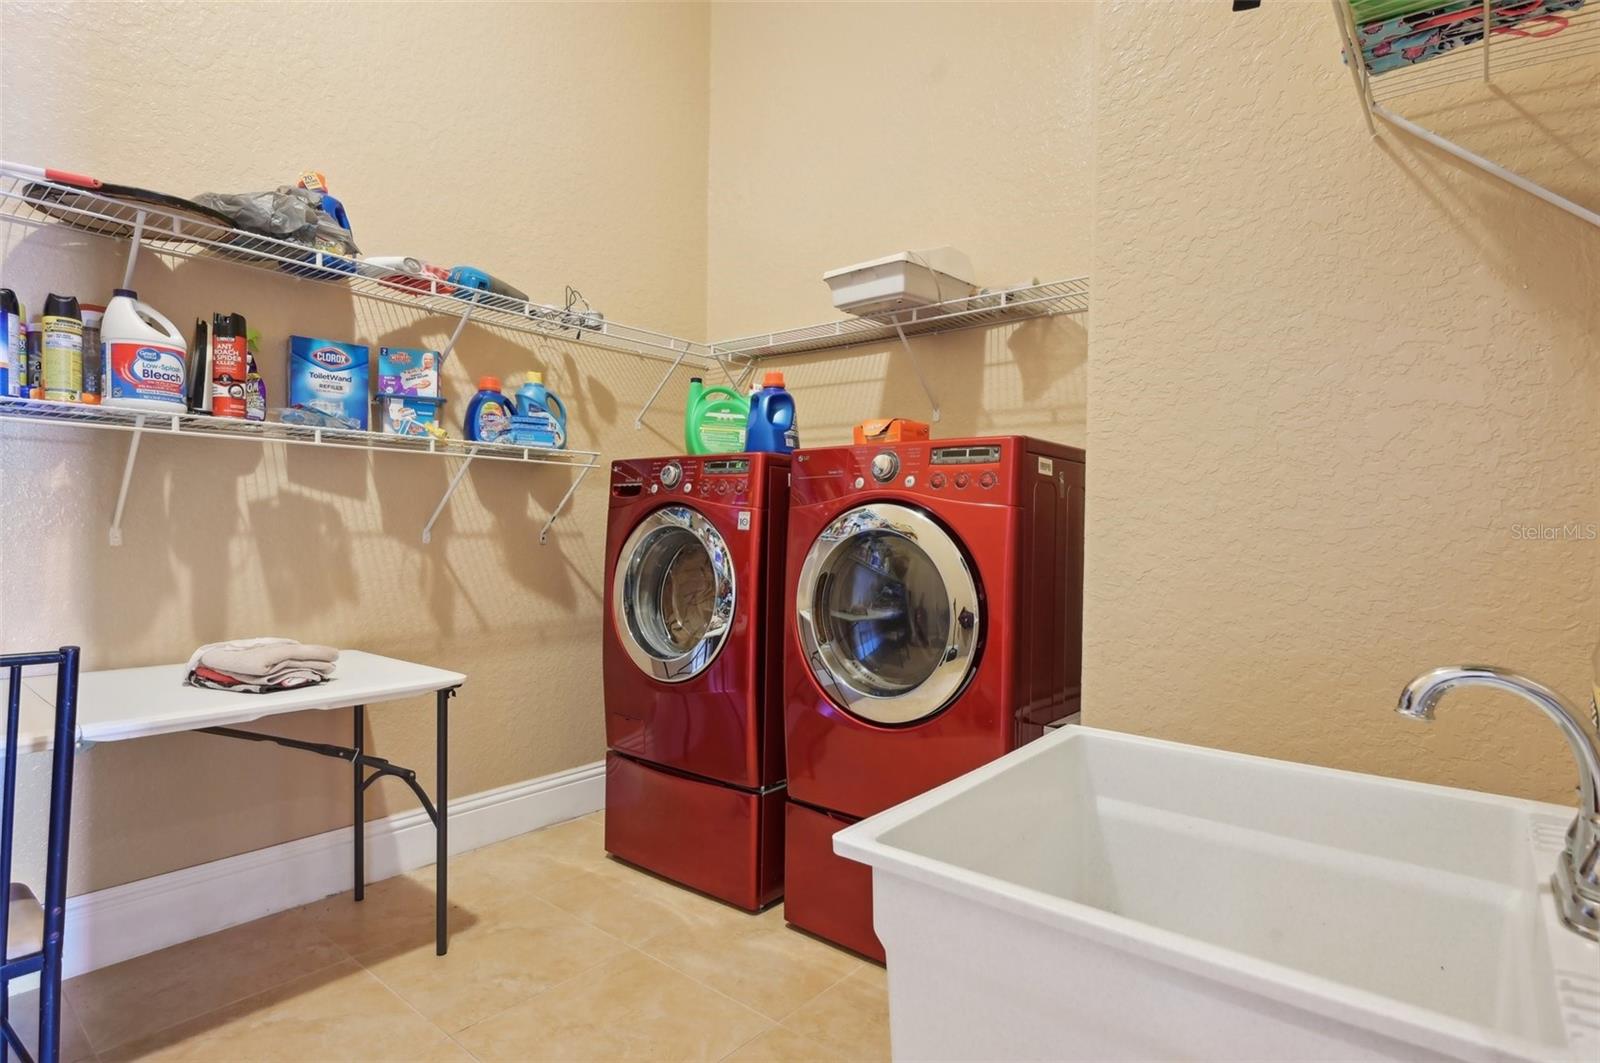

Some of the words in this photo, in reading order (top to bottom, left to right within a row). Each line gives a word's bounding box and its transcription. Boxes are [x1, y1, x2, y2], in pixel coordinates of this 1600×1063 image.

[317, 352, 346, 364] CLOROX
[142, 368, 181, 382] Bleach
[308, 371, 352, 383] ToiletWand
